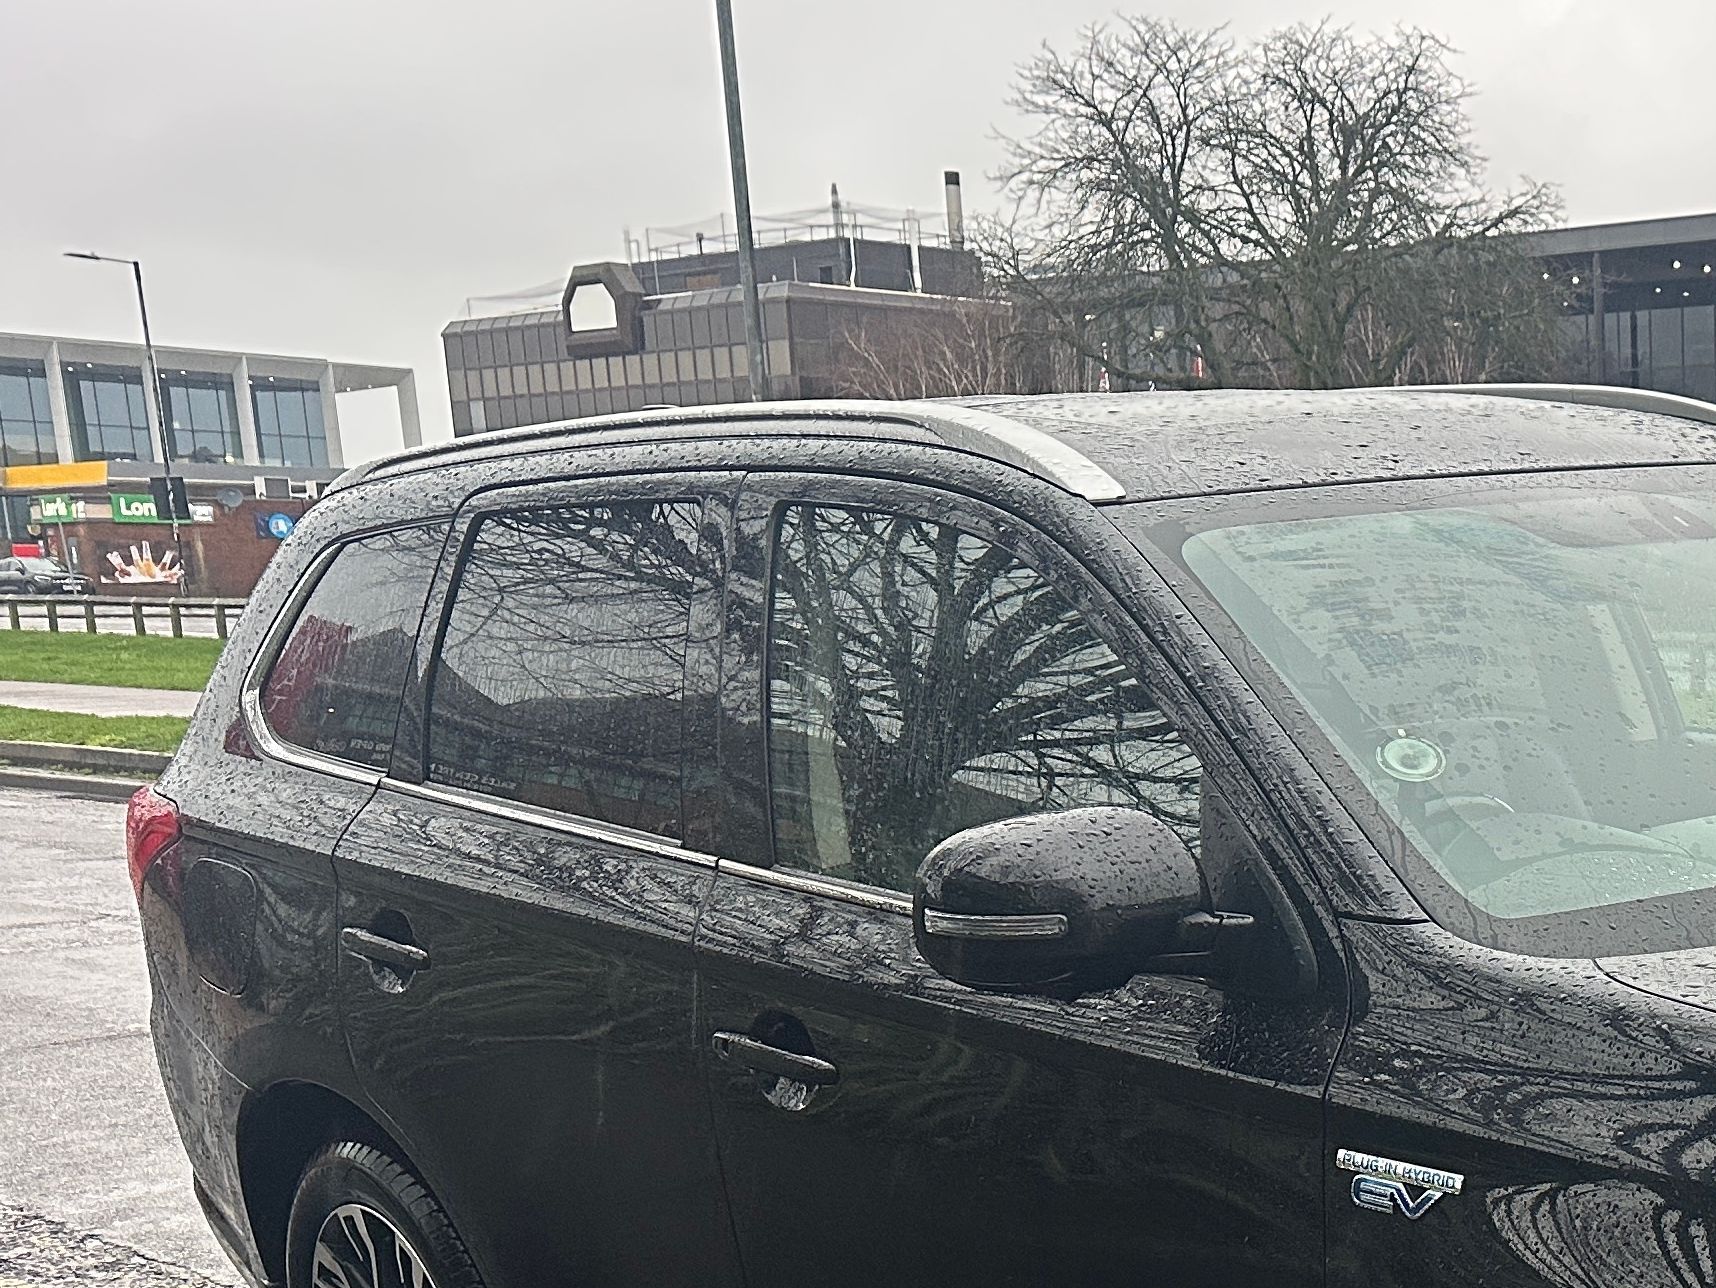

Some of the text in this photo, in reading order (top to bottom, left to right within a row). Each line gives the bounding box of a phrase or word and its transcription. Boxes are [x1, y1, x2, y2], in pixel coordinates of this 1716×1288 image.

[1342, 1152, 1456, 1188] PLUG-IN HYBRID
[1350, 1173, 1444, 1220] EV
